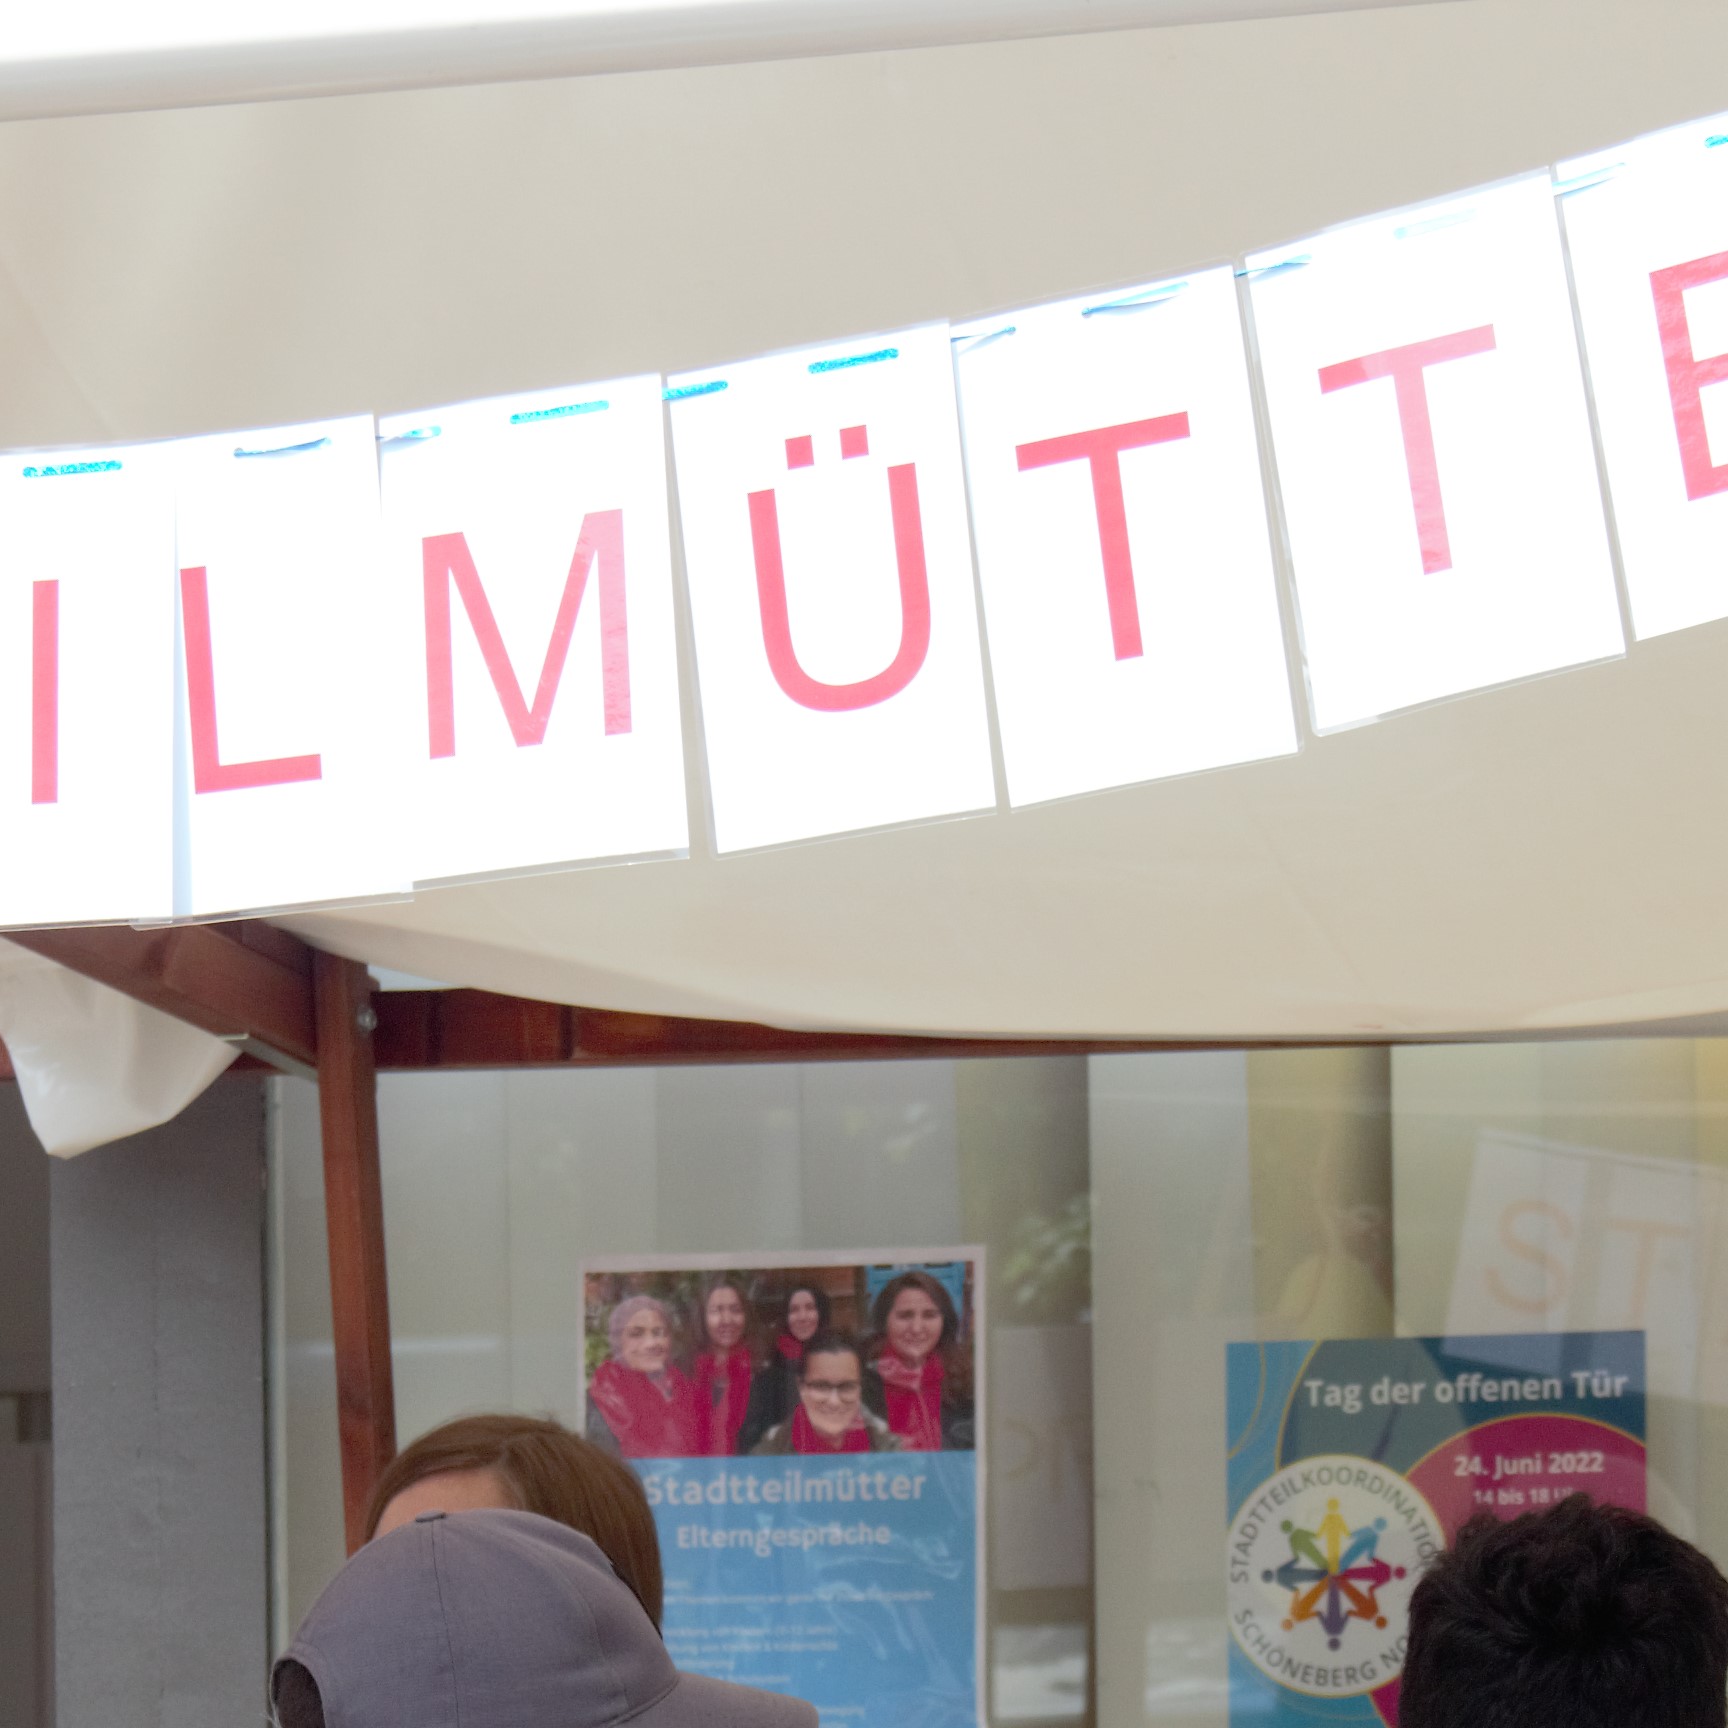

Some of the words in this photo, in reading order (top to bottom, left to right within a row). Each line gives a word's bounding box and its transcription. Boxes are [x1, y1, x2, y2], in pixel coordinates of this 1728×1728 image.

[1304, 1379, 1363, 1413] Tag
[1370, 1376, 1426, 1405] der
[1434, 1373, 1563, 1403] offenen
[1571, 1369, 1629, 1399] Tür
[1454, 1455, 1489, 1477] 24.
[1492, 1452, 1543, 1481] Juni
[1548, 1451, 1605, 1475] 2022
[646, 1467, 927, 1507] Stadtteilmütter
[1474, 1488, 1494, 1504] 14
[1498, 1487, 1524, 1505] bis
[1529, 1487, 1550, 1504] 18
[676, 1521, 892, 1557] Elterngespräche
[1230, 1465, 1437, 1584] STADTTEILKOORDINATIO
[1234, 1608, 1378, 1688] SCHÖNEBERG
